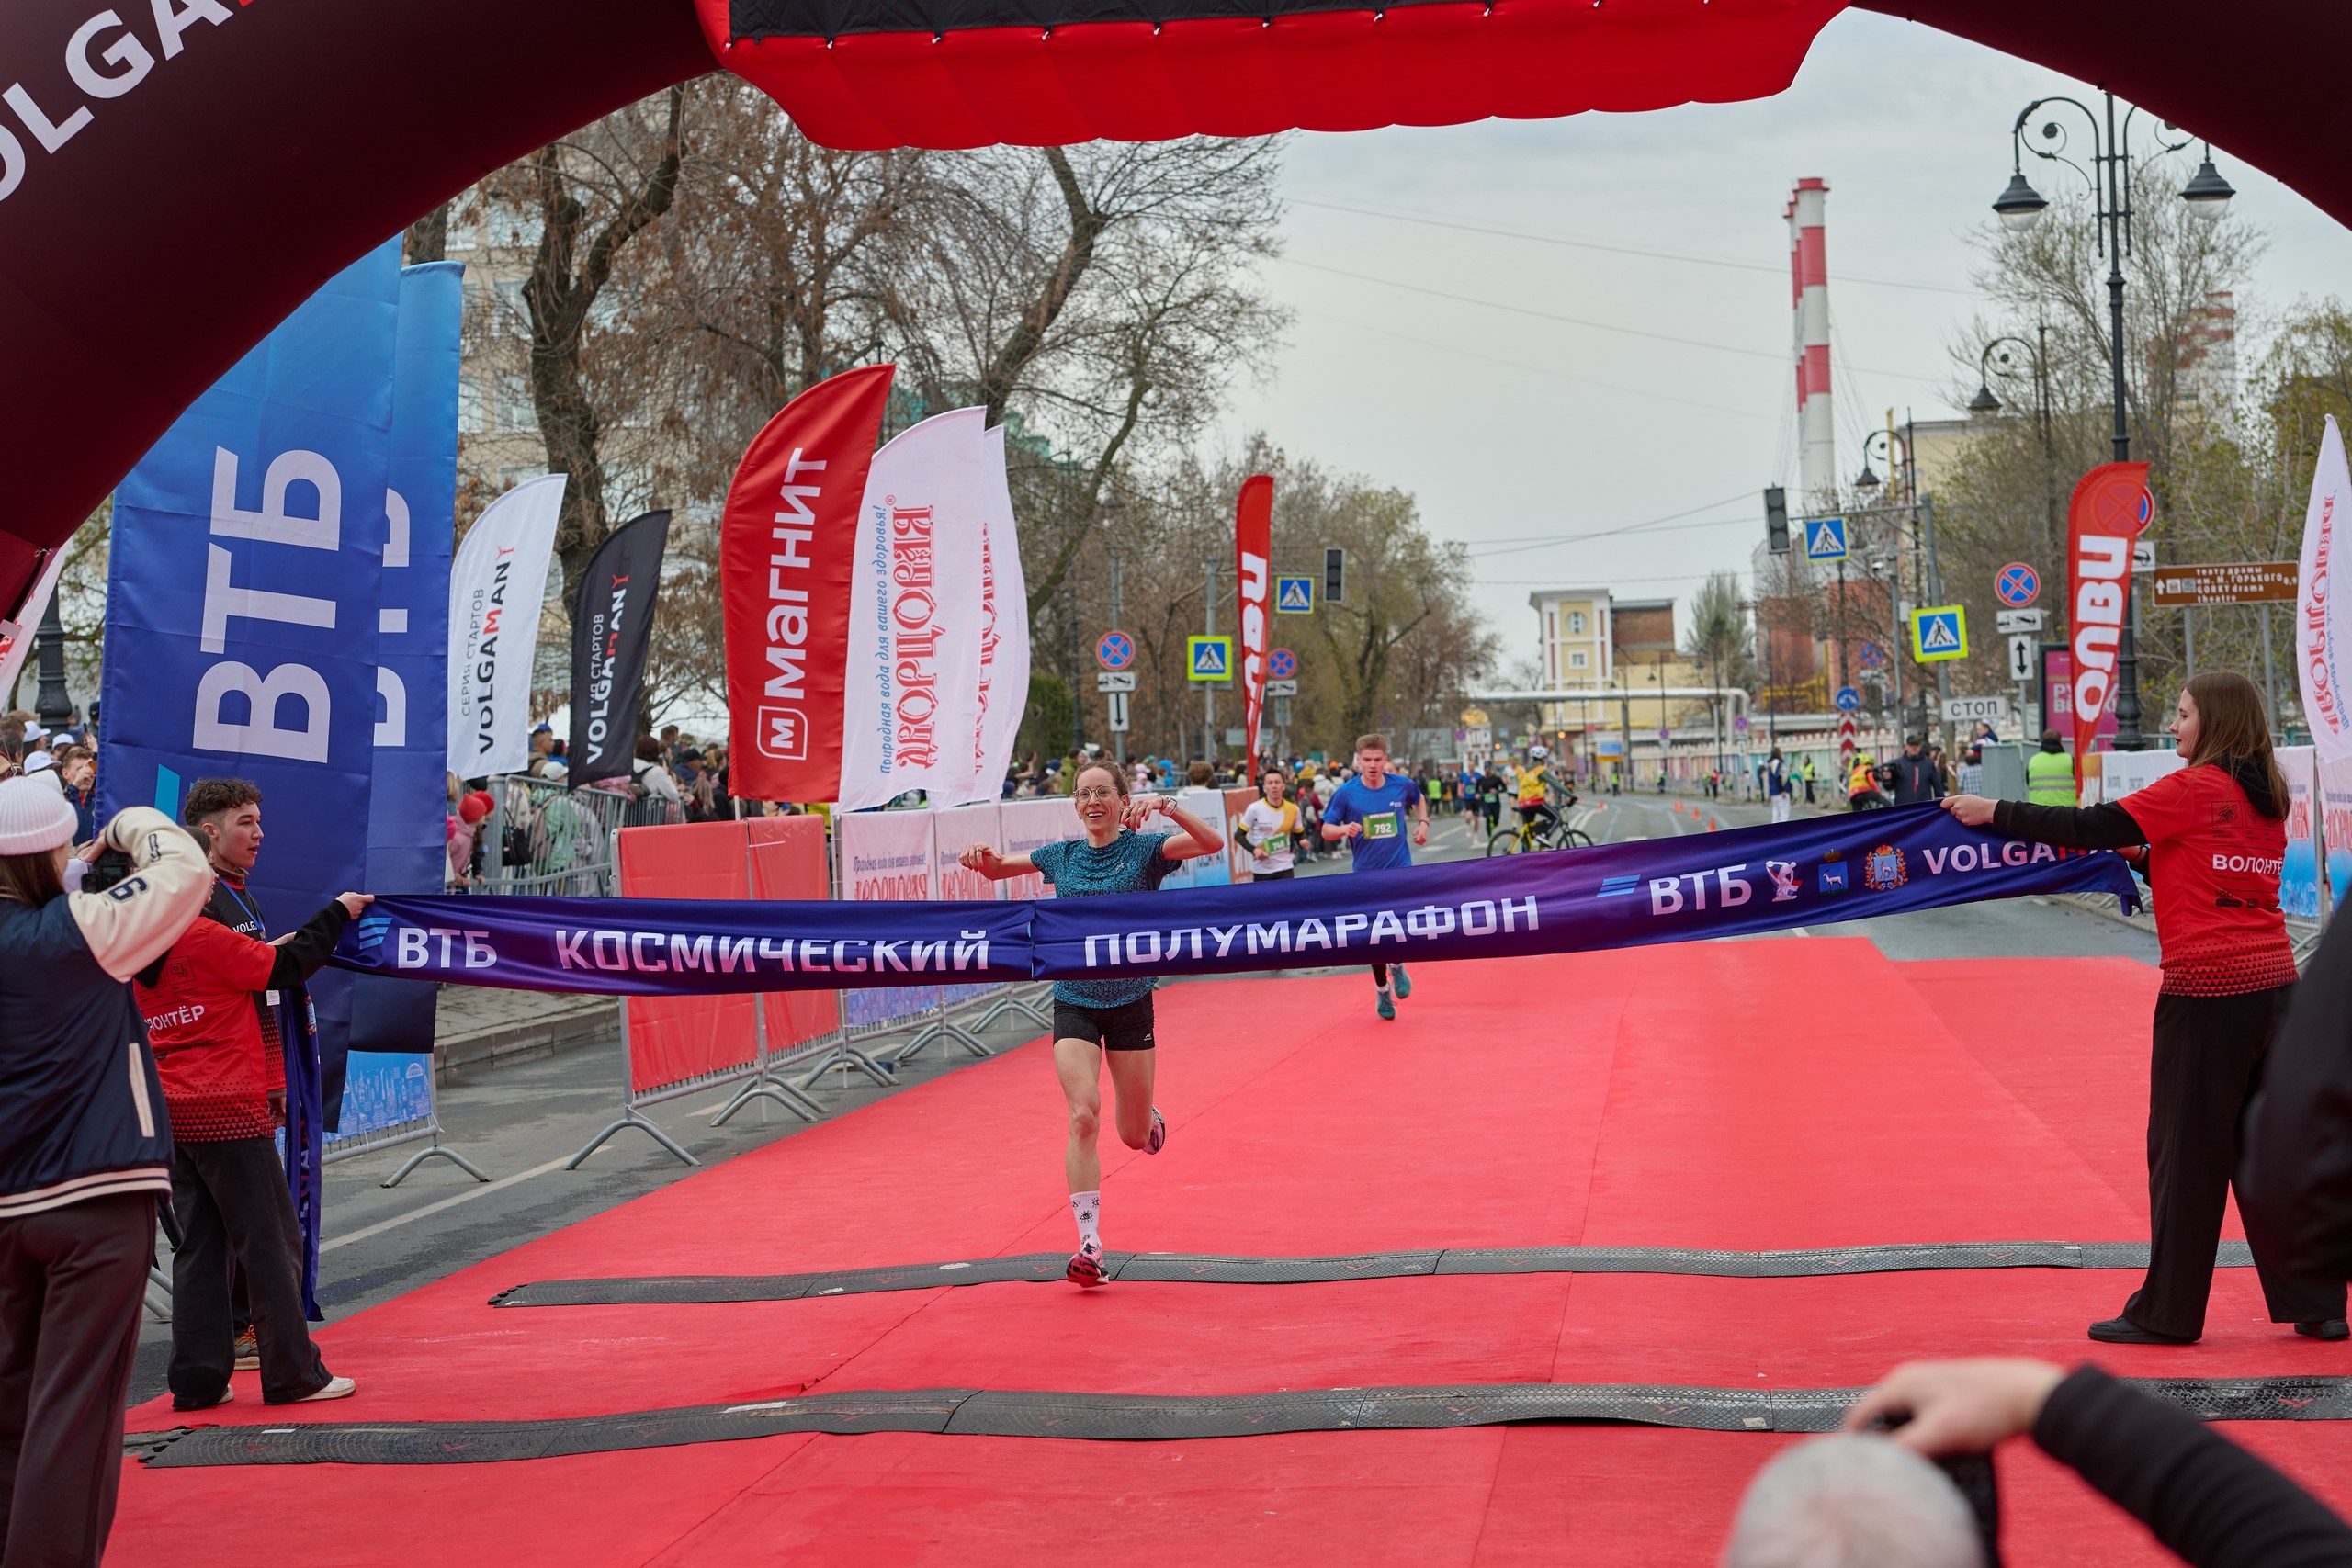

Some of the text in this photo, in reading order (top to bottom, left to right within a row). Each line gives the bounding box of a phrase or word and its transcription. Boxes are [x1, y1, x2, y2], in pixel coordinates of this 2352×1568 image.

[0, 0, 255, 202] LGA
[193, 446, 342, 763] ВТБ
[461, 589, 484, 717] СЕРИЯ СТАРТОВ
[591, 614, 605, 680] СТАРТОВ
[872, 505, 894, 773] Природная вода для вашего здоровья!
[1951, 701, 1997, 716] СТОП
[1374, 823, 1392, 835] 792
[1923, 840, 2113, 874] VOLGA
[232, 920, 258, 933] VOLG
[1084, 863, 1752, 967] ПОЛУМАРАФОН ВТБ
[397, 926, 991, 974] ВТБ КОСМИЧЕСКИЙ
[144, 1005, 205, 1031] ЛОНТЁР
